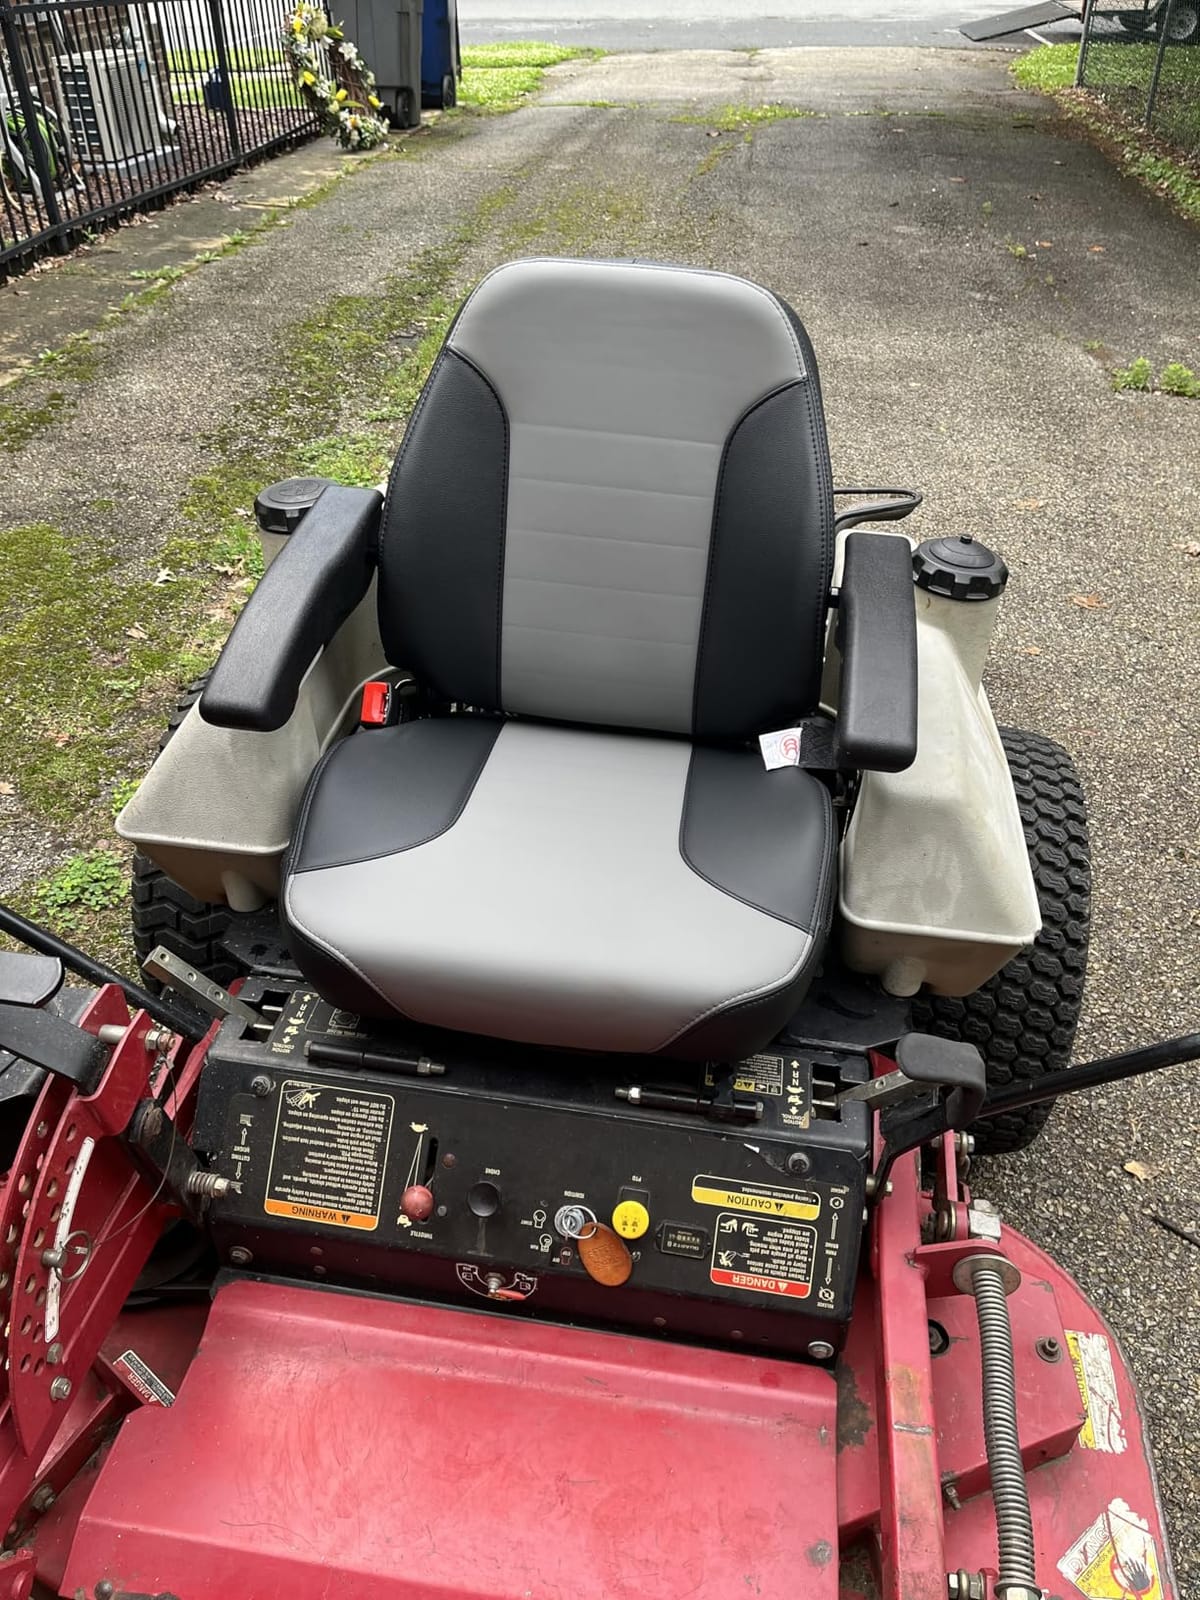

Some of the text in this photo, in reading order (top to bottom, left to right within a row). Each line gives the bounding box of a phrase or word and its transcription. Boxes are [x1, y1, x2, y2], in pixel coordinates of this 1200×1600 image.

[781, 1113, 805, 1121] CONTROL
[233, 1145, 250, 1153] HEIGHT
[231, 1153, 250, 1161] CUTTING
[564, 1190, 584, 1198] IGNITION
[726, 1194, 771, 1209] CAUTION
[291, 1206, 336, 1220] WARNING
[410, 1230, 432, 1239] THROTTLE
[732, 1274, 775, 1288] DANGER
[127, 1373, 151, 1397] DANGER
